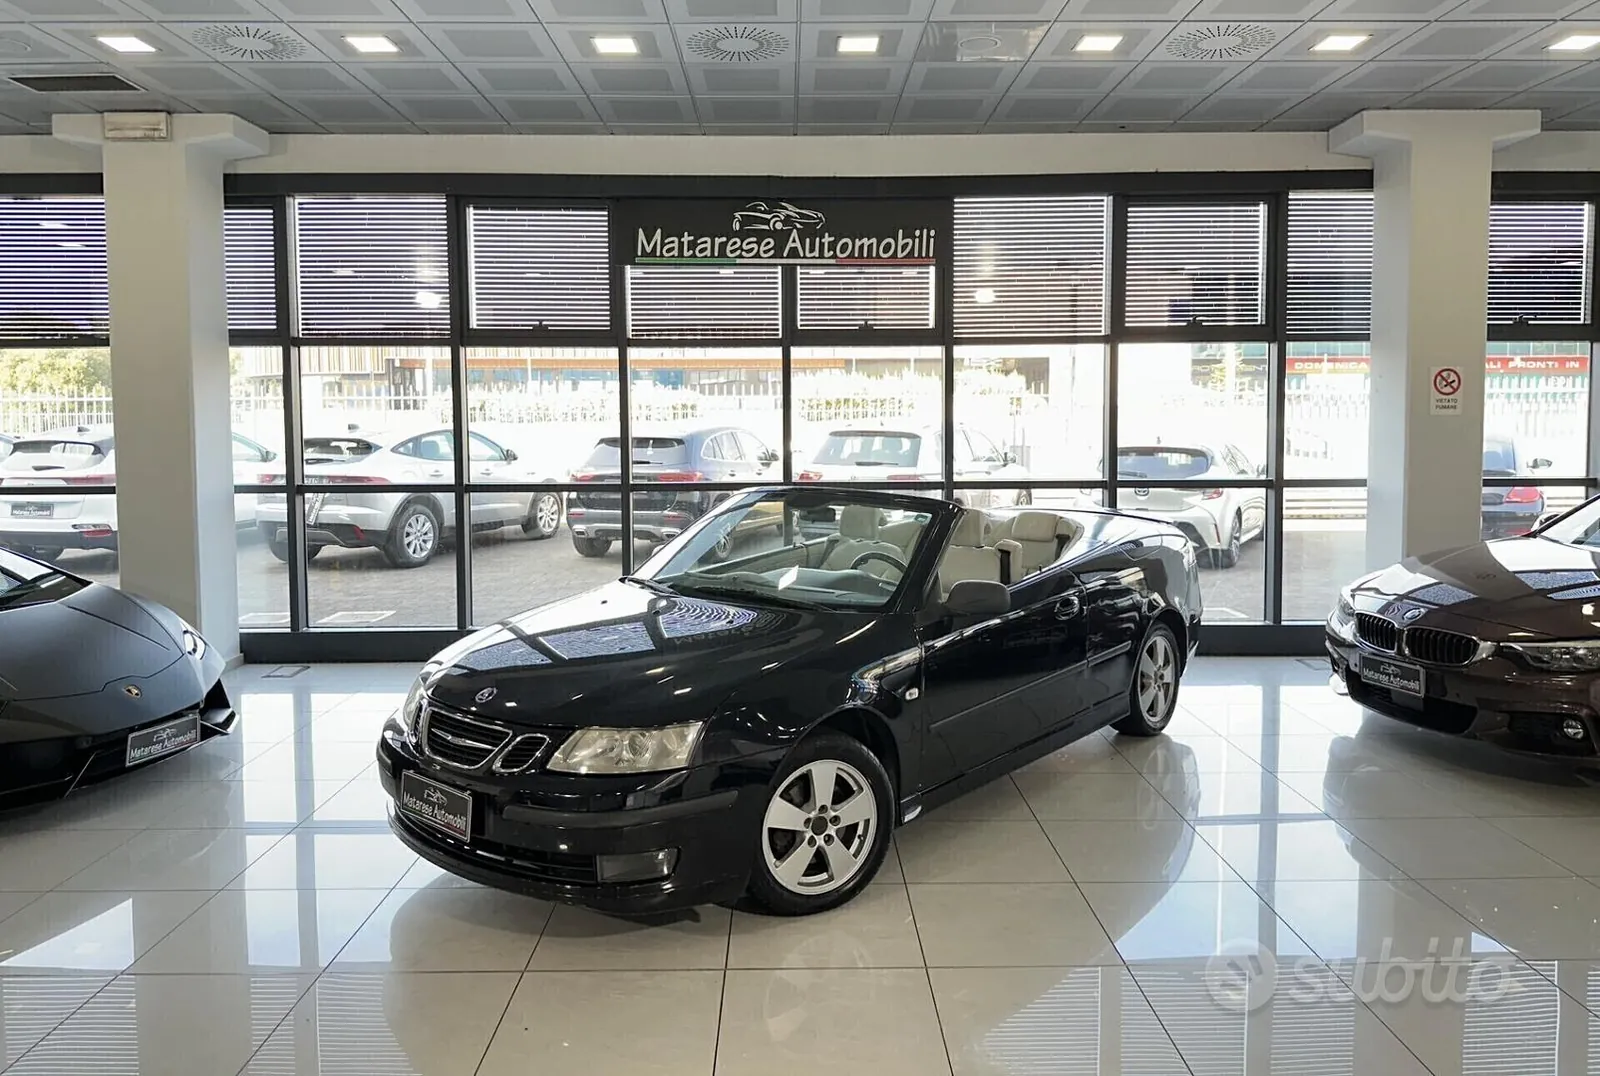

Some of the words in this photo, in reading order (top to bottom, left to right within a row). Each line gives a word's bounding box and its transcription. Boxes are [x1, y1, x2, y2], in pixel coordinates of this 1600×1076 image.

[636, 227, 775, 258] Matarese
[783, 228, 937, 258] Automobili
[1508, 360, 1559, 369] PRONTI
[1565, 360, 1580, 369] IN
[130, 742, 162, 759] Matarese
[163, 729, 196, 748] Automobili
[403, 791, 433, 816] Matarese
[433, 805, 466, 831] Automobili
